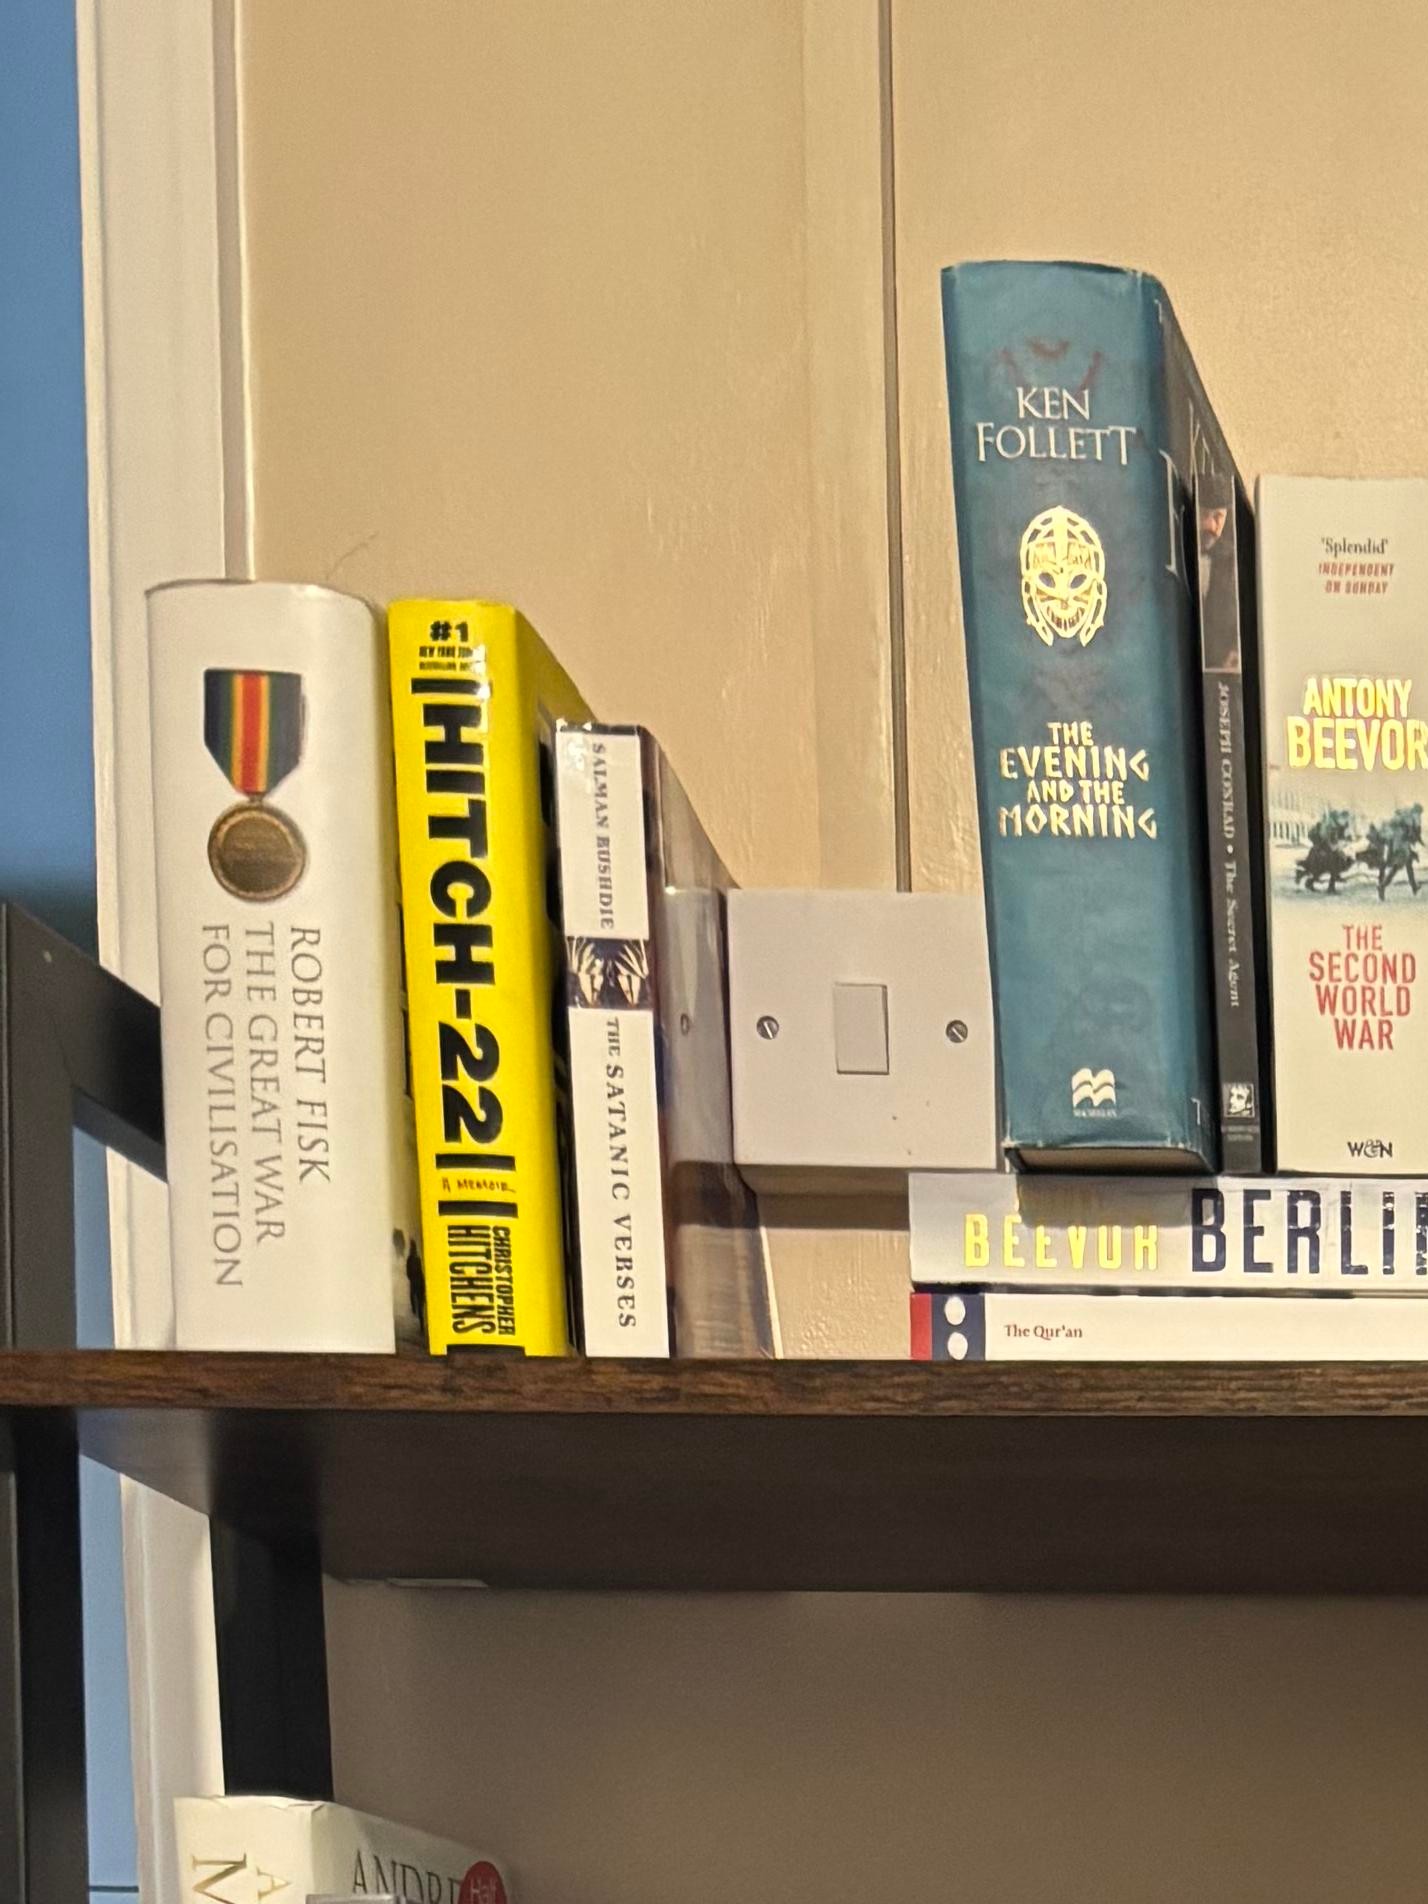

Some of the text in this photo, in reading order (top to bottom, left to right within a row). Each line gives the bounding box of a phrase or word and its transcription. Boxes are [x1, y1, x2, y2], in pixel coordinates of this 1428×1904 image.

[1016, 387, 1090, 419] KEN
[976, 424, 1136, 464] FOLLETT
[1302, 677, 1412, 718] ANTONY
[422, 704, 503, 1143] HITCH-22
[1342, 925, 1382, 950] THE
[1309, 952, 1416, 983] SECOND
[1316, 986, 1411, 1016] WORLD
[1334, 1019, 1394, 1050] WAR
[290, 927, 331, 1185] ROBERT FISK
[245, 922, 285, 1244] THE GREAT WAR
[202, 924, 243, 1288] FOR CIVILISATION
[606, 1018, 636, 1329] THE SATANIC VERSES
[1005, 1323, 1082, 1341] The Qur'an
